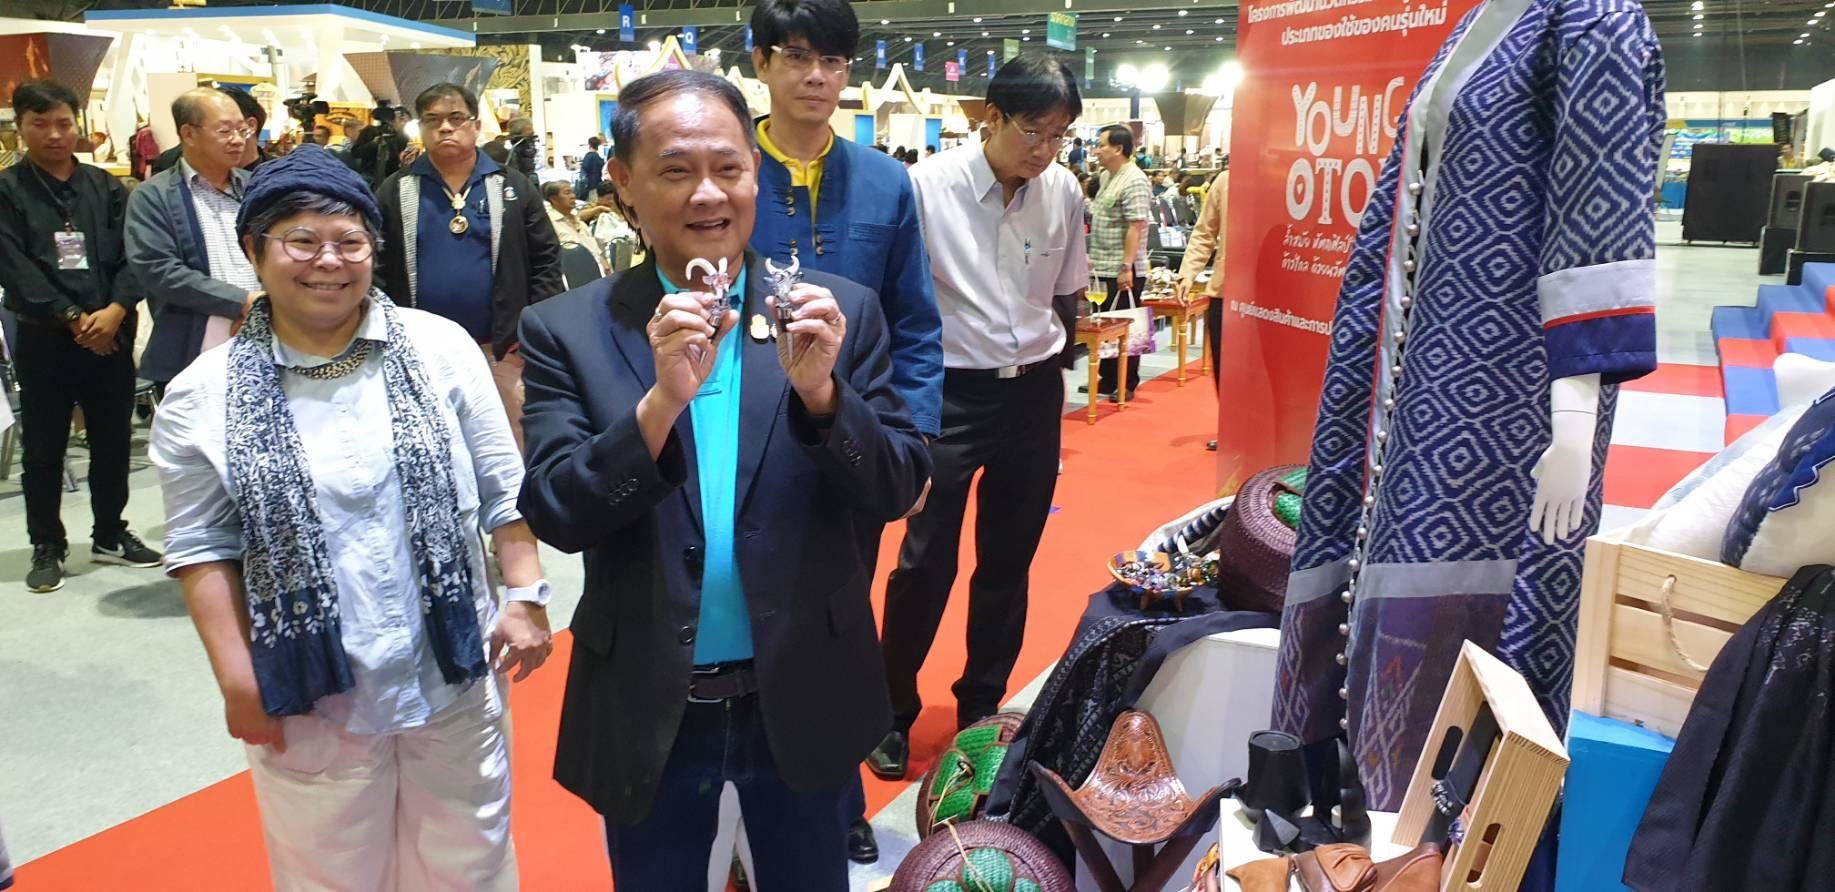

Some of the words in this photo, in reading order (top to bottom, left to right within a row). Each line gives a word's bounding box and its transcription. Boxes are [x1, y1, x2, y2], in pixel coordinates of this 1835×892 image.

[622, 15, 630, 28] R
[1281, 1, 1447, 46] ประเภทของใช้ของคนรุ่นใหม่
[685, 32, 694, 44] Q
[1286, 157, 1387, 228] OTO
